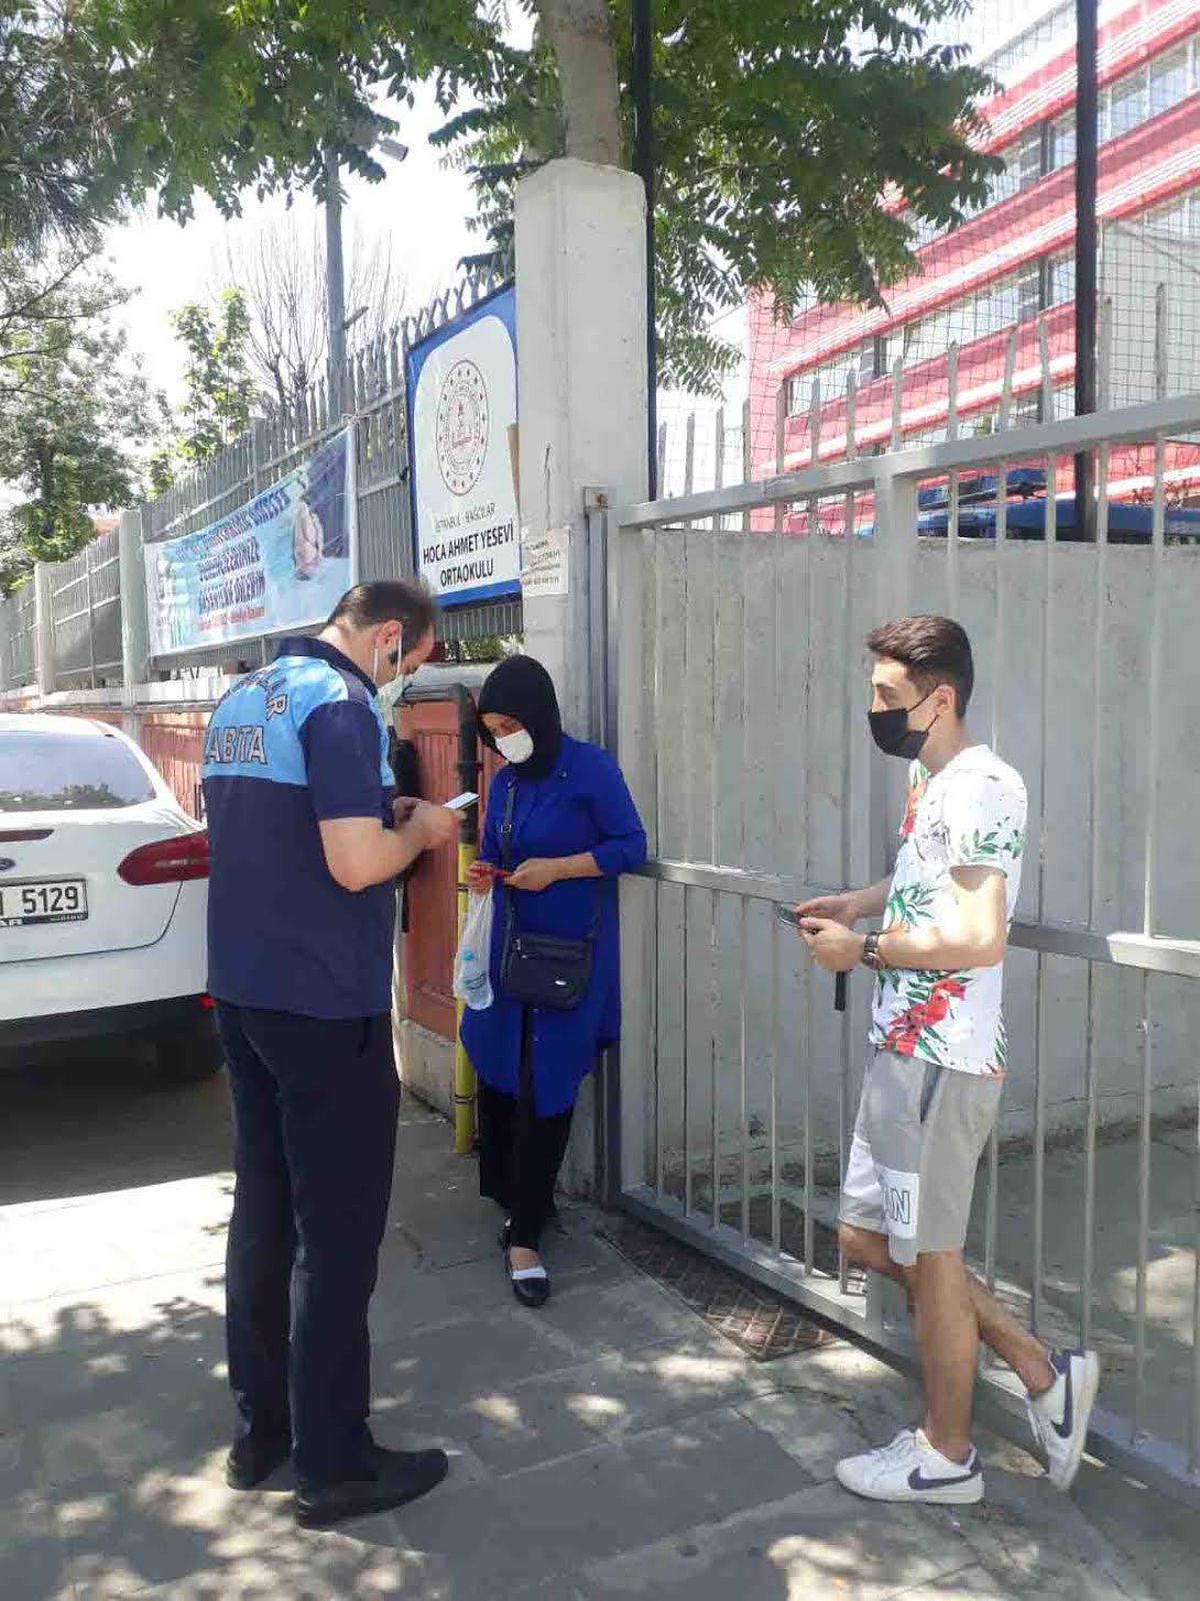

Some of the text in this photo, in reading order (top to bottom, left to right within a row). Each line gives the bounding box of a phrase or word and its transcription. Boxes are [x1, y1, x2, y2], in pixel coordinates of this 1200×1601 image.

[423, 518, 514, 564] HOCA AHMET YESEVİ
[440, 559, 494, 587] ORTAOKULU
[22, 886, 78, 914] 5129
